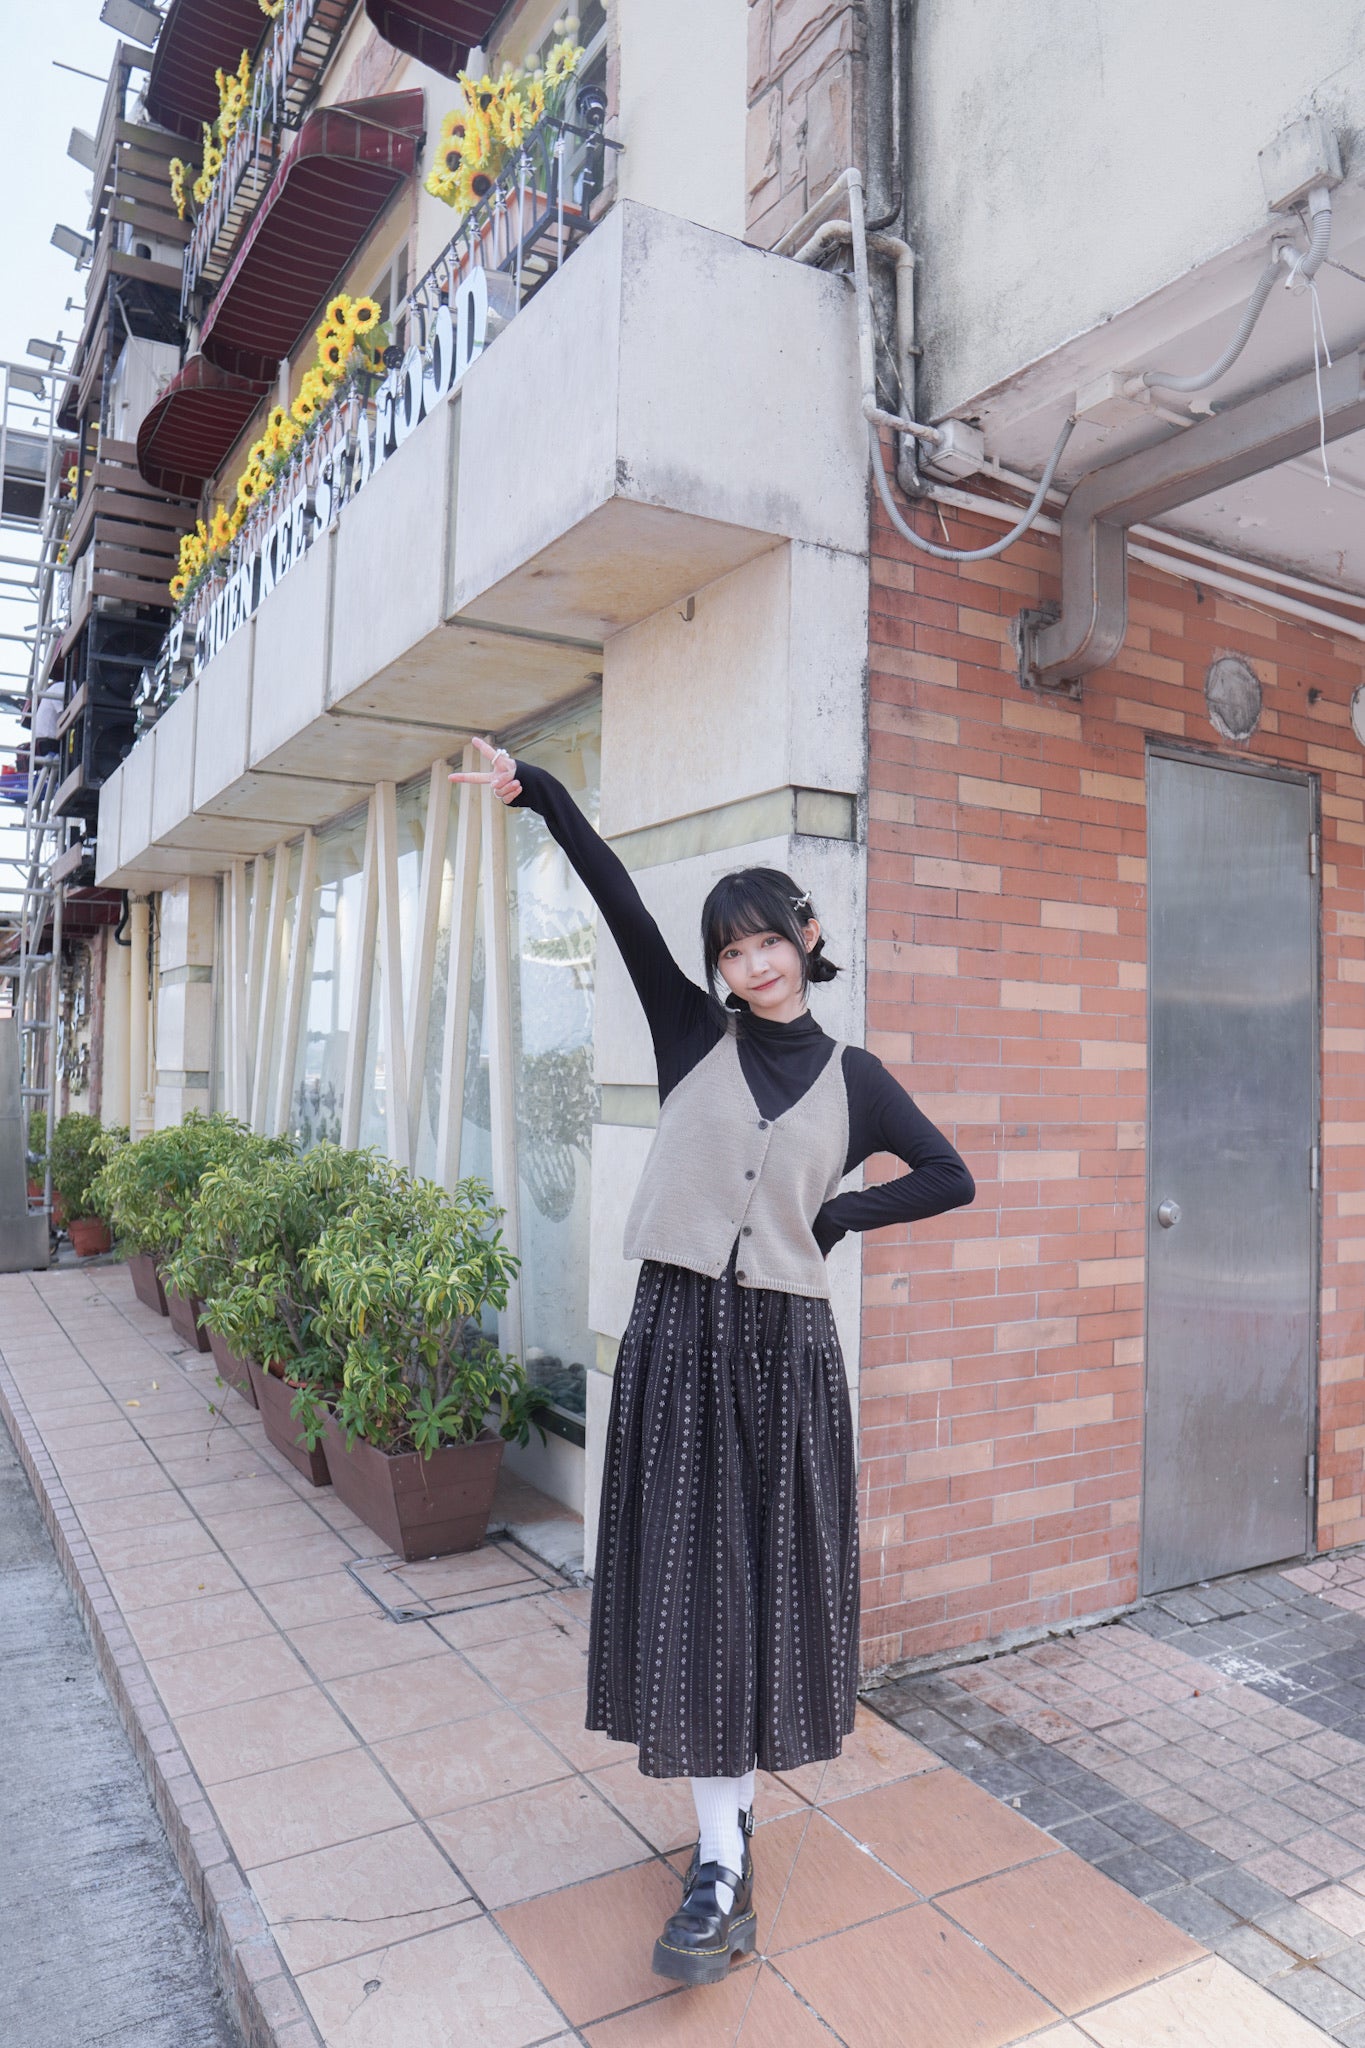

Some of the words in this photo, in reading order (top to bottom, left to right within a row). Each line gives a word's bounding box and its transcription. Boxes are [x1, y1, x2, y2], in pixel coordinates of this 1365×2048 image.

[194, 551, 256, 677] CHUEN
[258, 484, 308, 606] KEE
[313, 265, 488, 543] SEAFOOD
